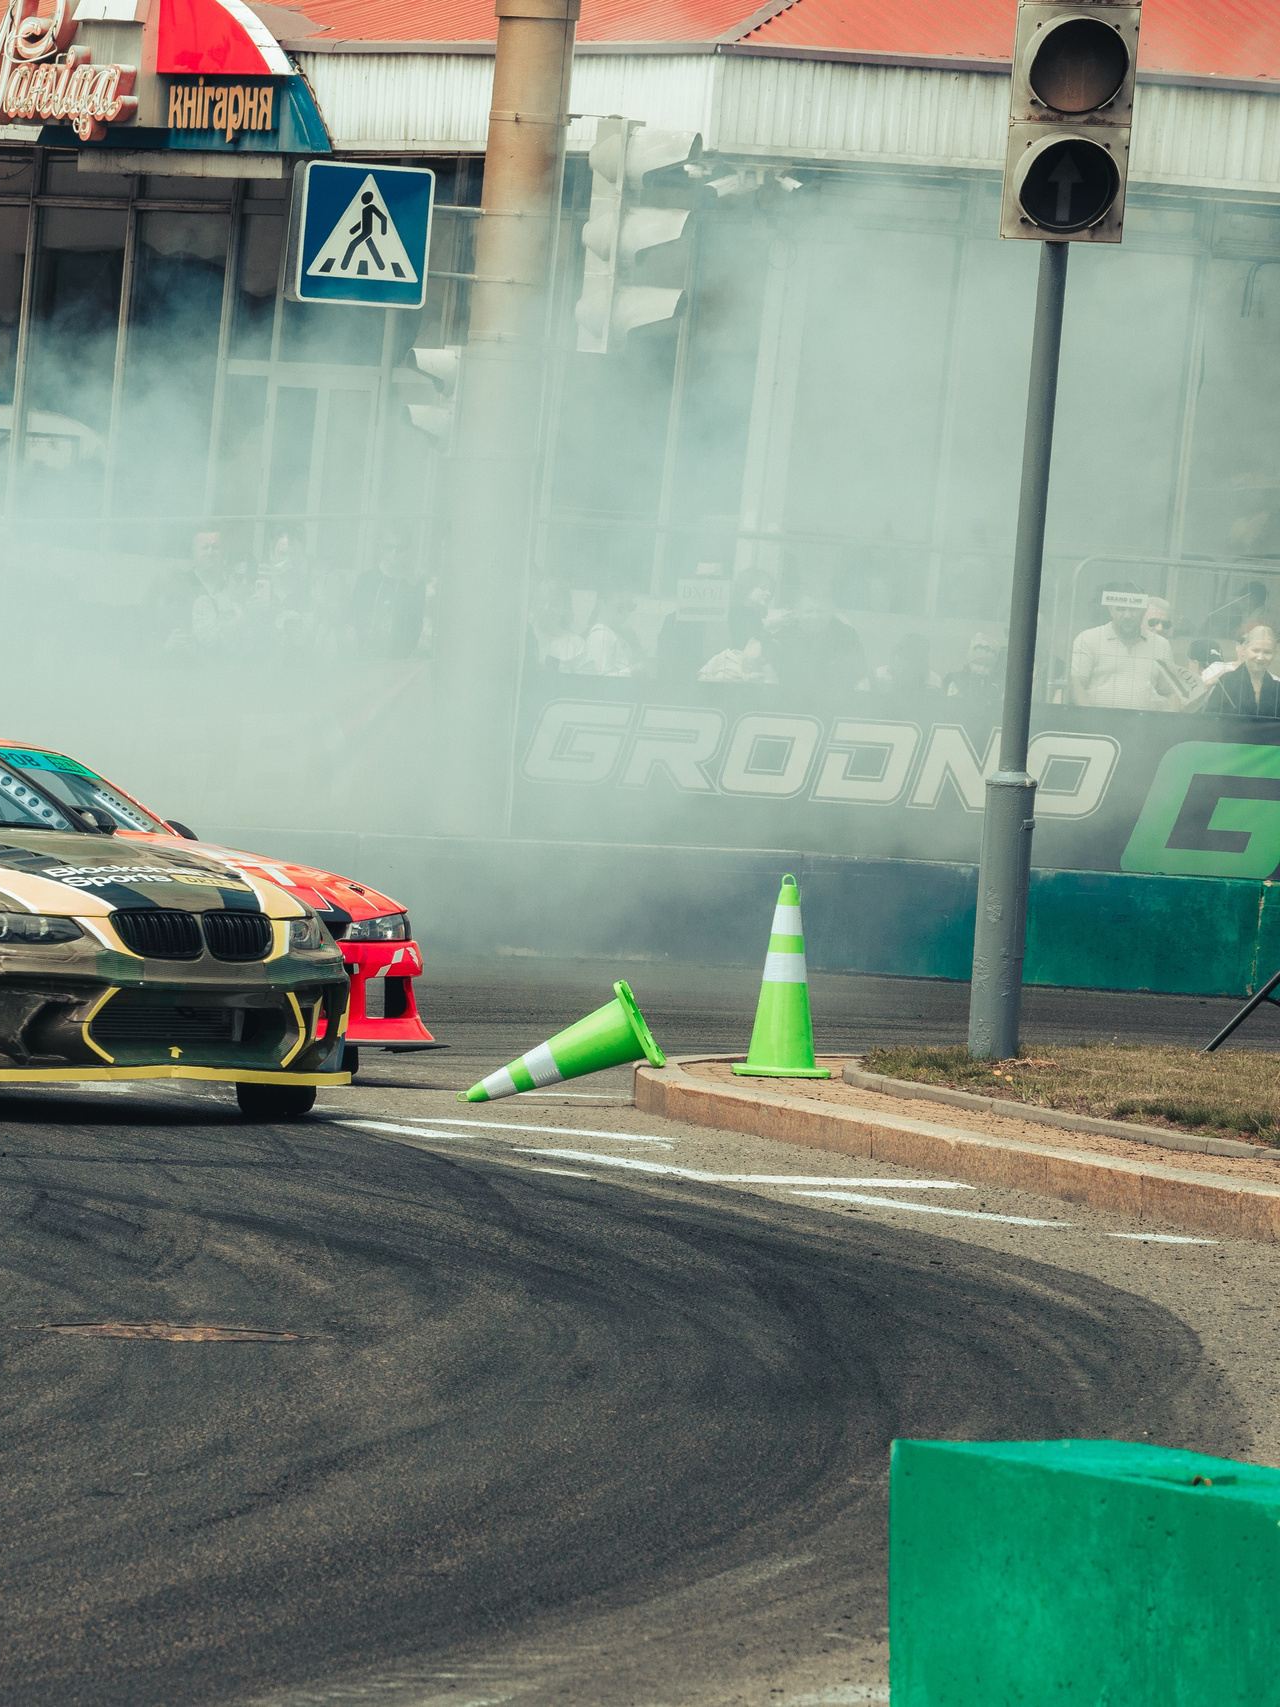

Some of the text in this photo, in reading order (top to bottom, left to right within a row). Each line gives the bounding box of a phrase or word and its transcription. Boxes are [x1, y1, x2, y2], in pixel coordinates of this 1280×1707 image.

[167, 76, 274, 143] кнігарня
[521, 698, 1121, 820] GRODNO
[42, 864, 215, 878] Blockchain
[61, 872, 173, 888] Sports
